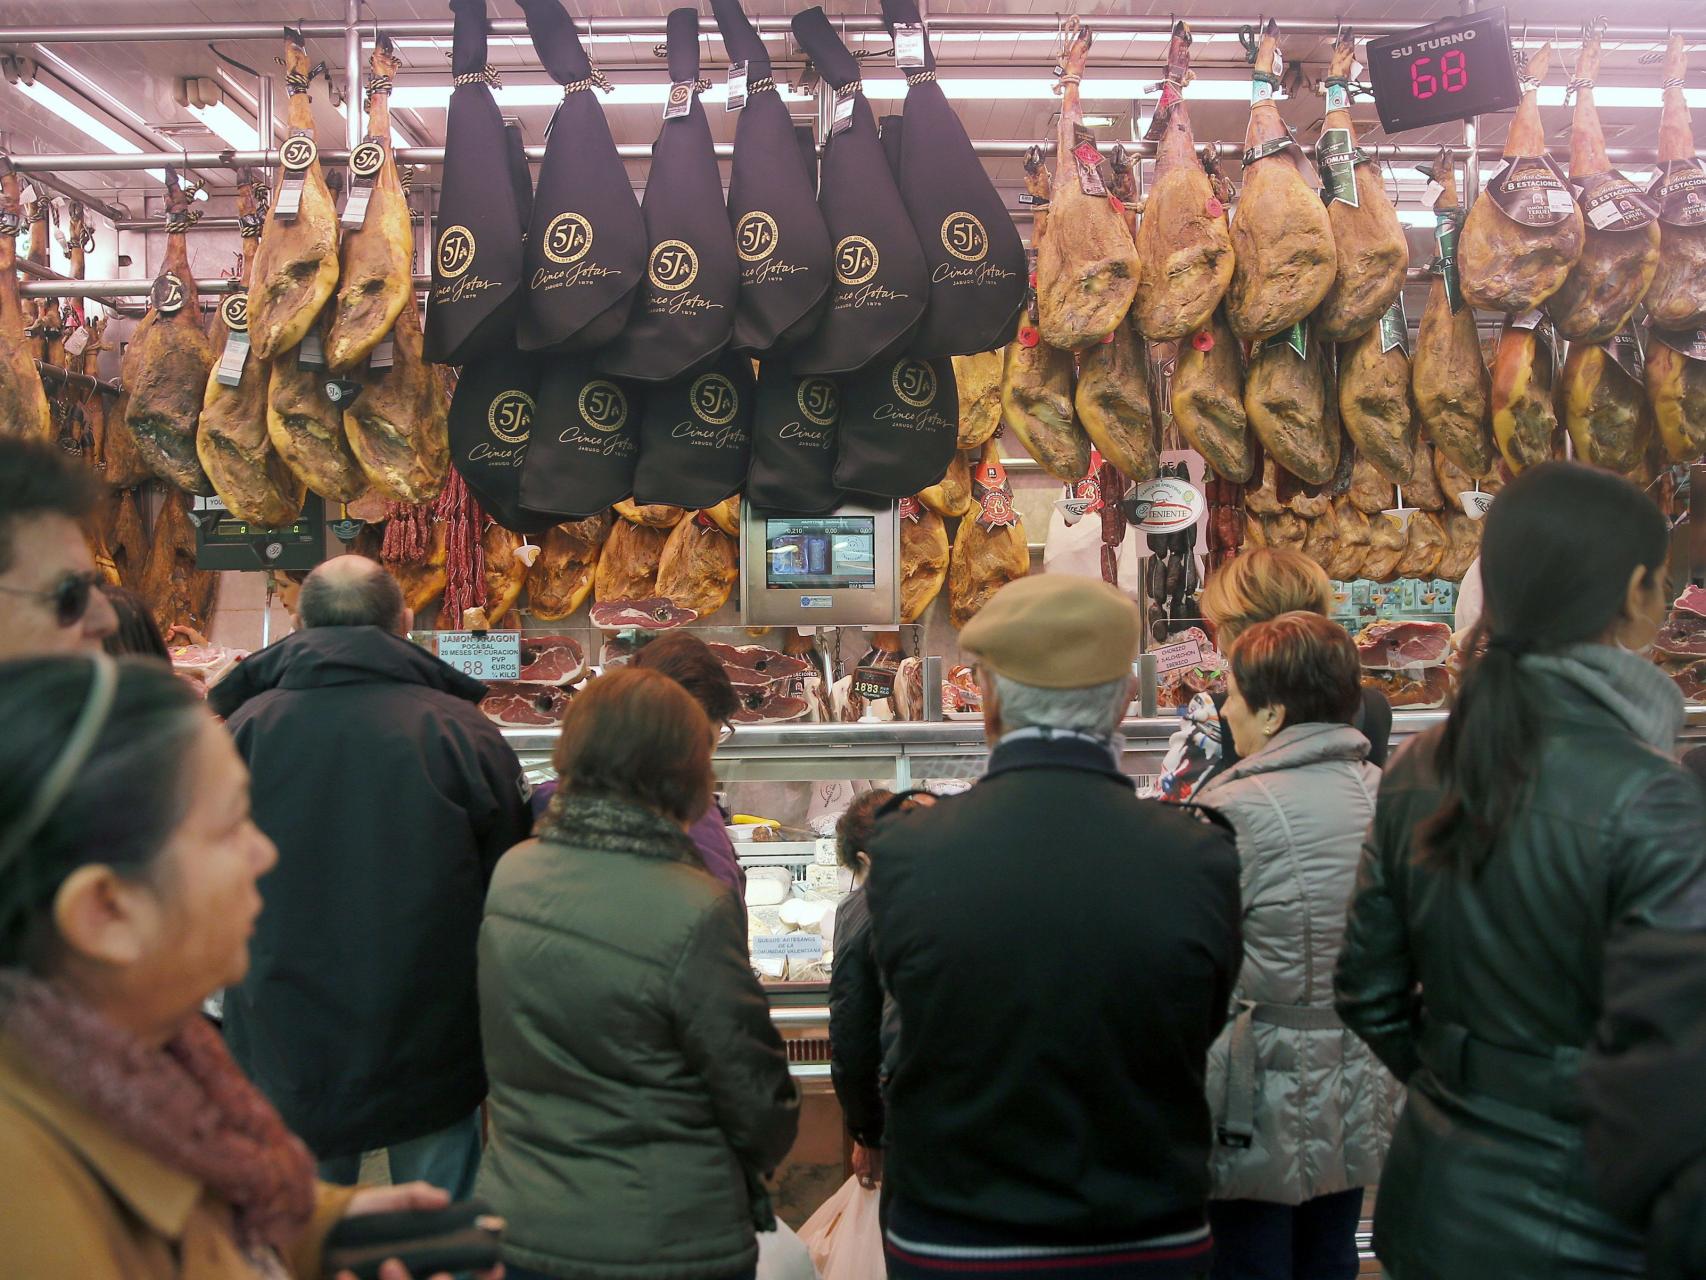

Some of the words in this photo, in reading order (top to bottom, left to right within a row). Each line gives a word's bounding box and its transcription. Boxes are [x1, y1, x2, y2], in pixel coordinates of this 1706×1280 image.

[1391, 46, 1413, 59] SU
[1417, 29, 1477, 52] TURNO
[1410, 49, 1467, 99] 68
[1516, 180, 1563, 188] ESTACIONES
[553, 223, 581, 254] 5J
[742, 221, 767, 252] 5J
[953, 222, 976, 252] 5J
[443, 236, 465, 268] 5J
[657, 251, 687, 281] 5J
[841, 246, 867, 276] 5J
[531, 267, 565, 290] Cinco
[565, 260, 622, 287] Jotas
[756, 257, 809, 284] Jotas
[932, 262, 973, 283] Cinco
[974, 261, 1017, 286] Jotas
[668, 291, 725, 315] Jotas
[854, 282, 909, 308] Jotas
[902, 367, 927, 396] 5J
[589, 391, 617, 420] 5J
[701, 385, 728, 414] 5J
[808, 386, 833, 415] 5J
[872, 403, 915, 420] Cinco
[499, 401, 528, 433] 5J
[671, 420, 715, 438] Cinco
[780, 421, 822, 439] Cinco
[558, 426, 603, 443] Cinco
[468, 442, 513, 460] Cinco
[442, 635, 473, 643] JAMON
[1161, 645, 1186, 656] CHORIZO
